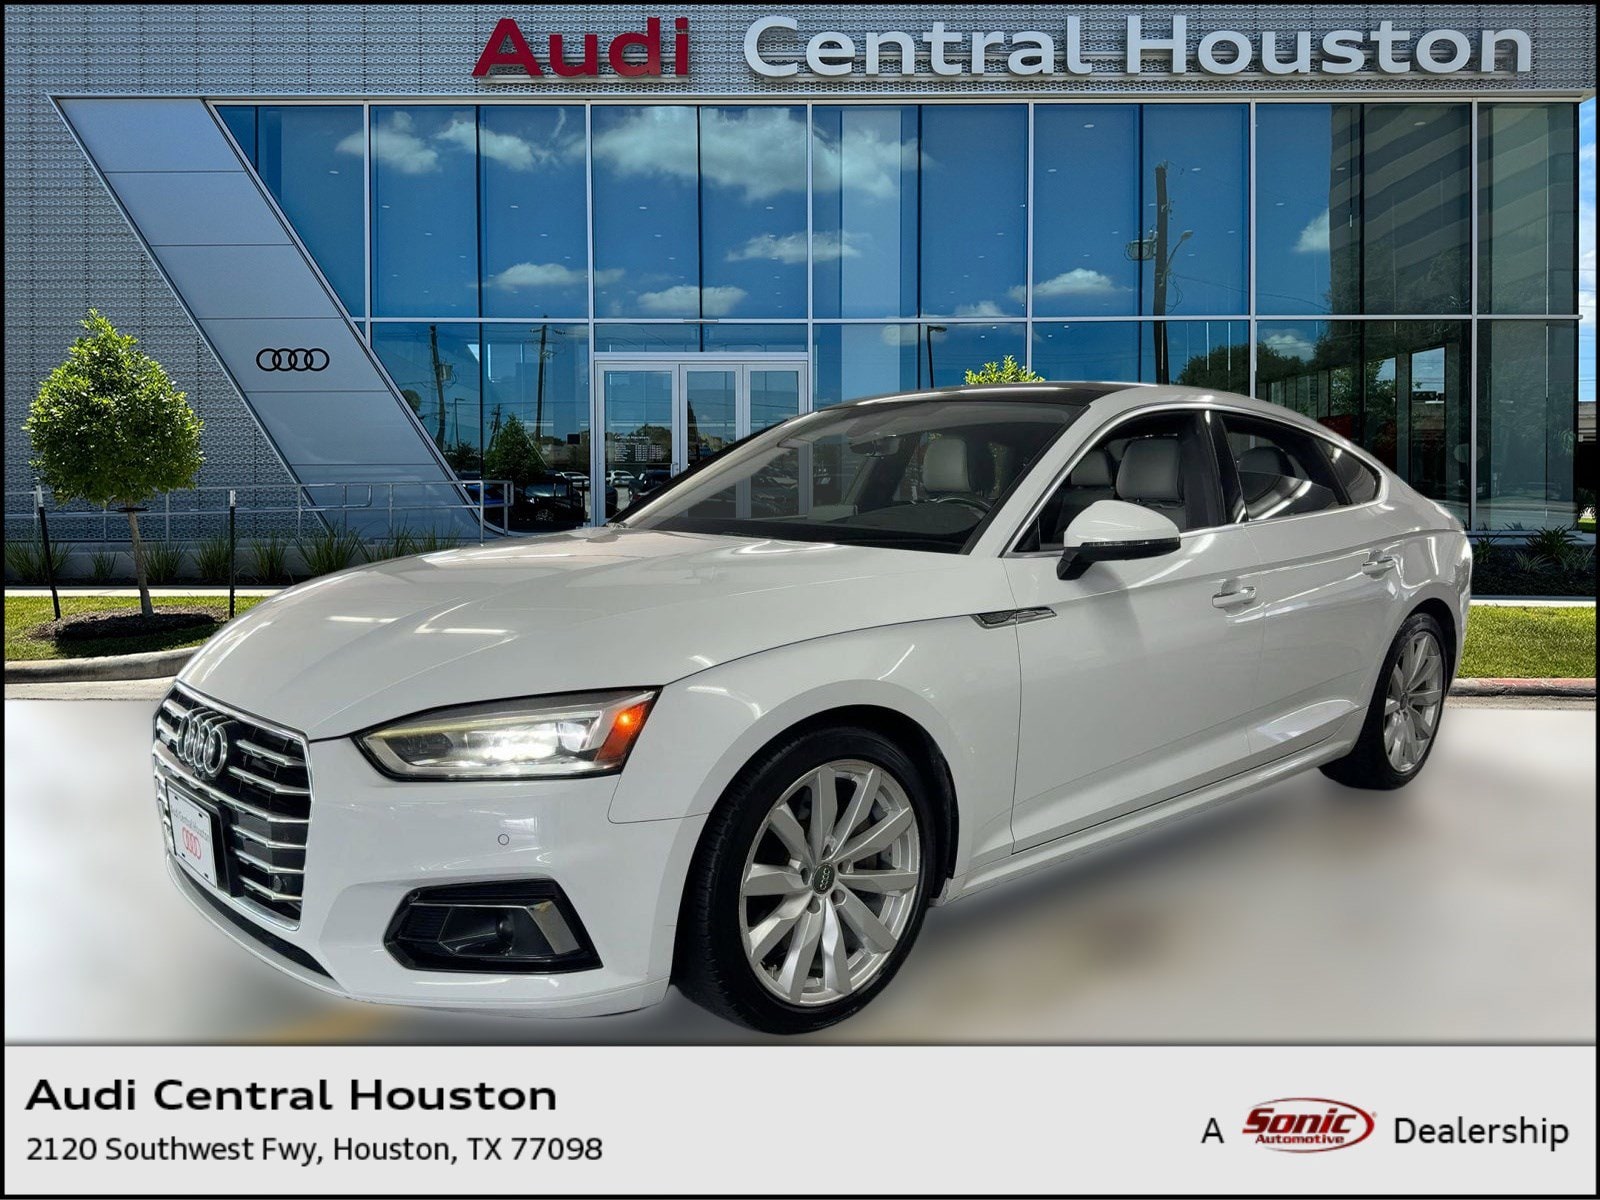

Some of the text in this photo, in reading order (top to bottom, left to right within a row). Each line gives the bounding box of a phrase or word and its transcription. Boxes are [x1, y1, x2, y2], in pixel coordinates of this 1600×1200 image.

[472, 15, 1532, 78] Audi Central Houston
